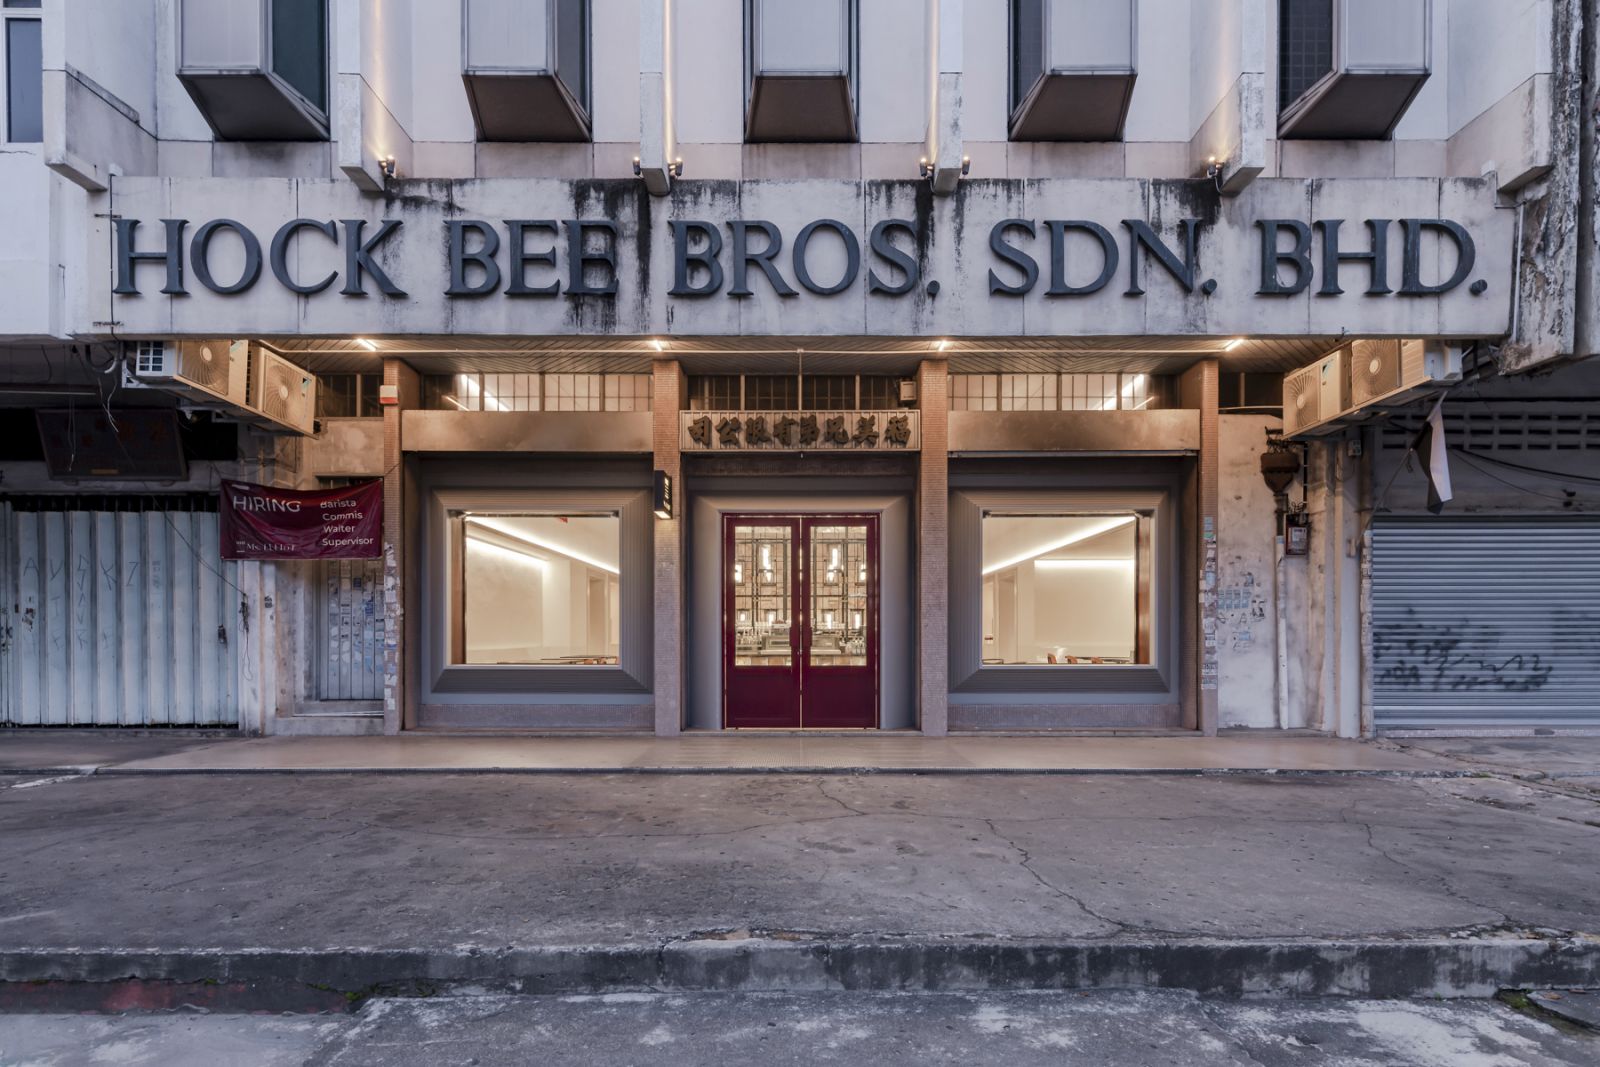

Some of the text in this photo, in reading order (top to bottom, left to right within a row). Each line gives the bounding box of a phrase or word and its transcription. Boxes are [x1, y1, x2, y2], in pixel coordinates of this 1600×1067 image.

[111, 217, 1488, 299] HOCK BEE BROS. SDN. BHD.
[232, 495, 301, 513] HIRING
[320, 499, 357, 509] Barista
[322, 510, 363, 521] Commis
[323, 525, 355, 533] Waiter
[322, 535, 374, 548] Supervisor
